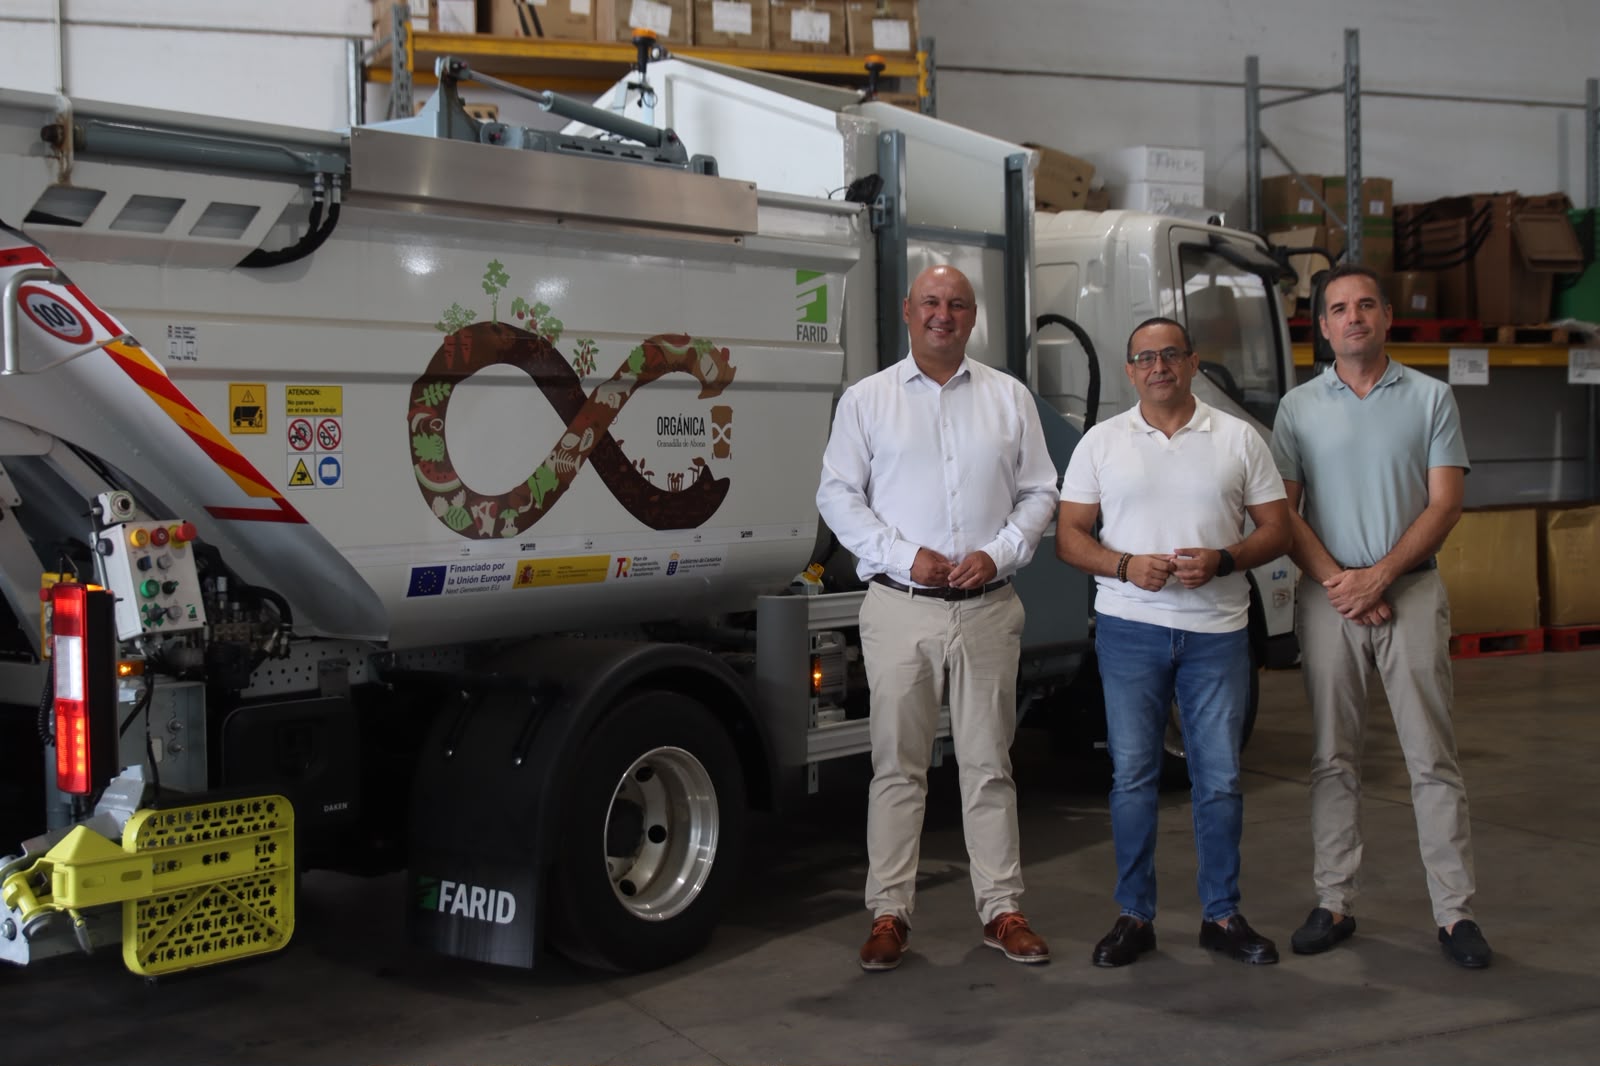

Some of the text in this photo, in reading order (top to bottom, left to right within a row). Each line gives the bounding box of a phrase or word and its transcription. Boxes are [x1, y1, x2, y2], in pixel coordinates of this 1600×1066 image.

[32, 302, 77, 328] 100
[796, 324, 828, 343] FARID
[657, 413, 706, 436] ORGÁNICA
[683, 439, 689, 448] de
[450, 562, 505, 573] Financiado por
[448, 574, 511, 585] la Unión Europea
[438, 880, 517, 925] FARID
